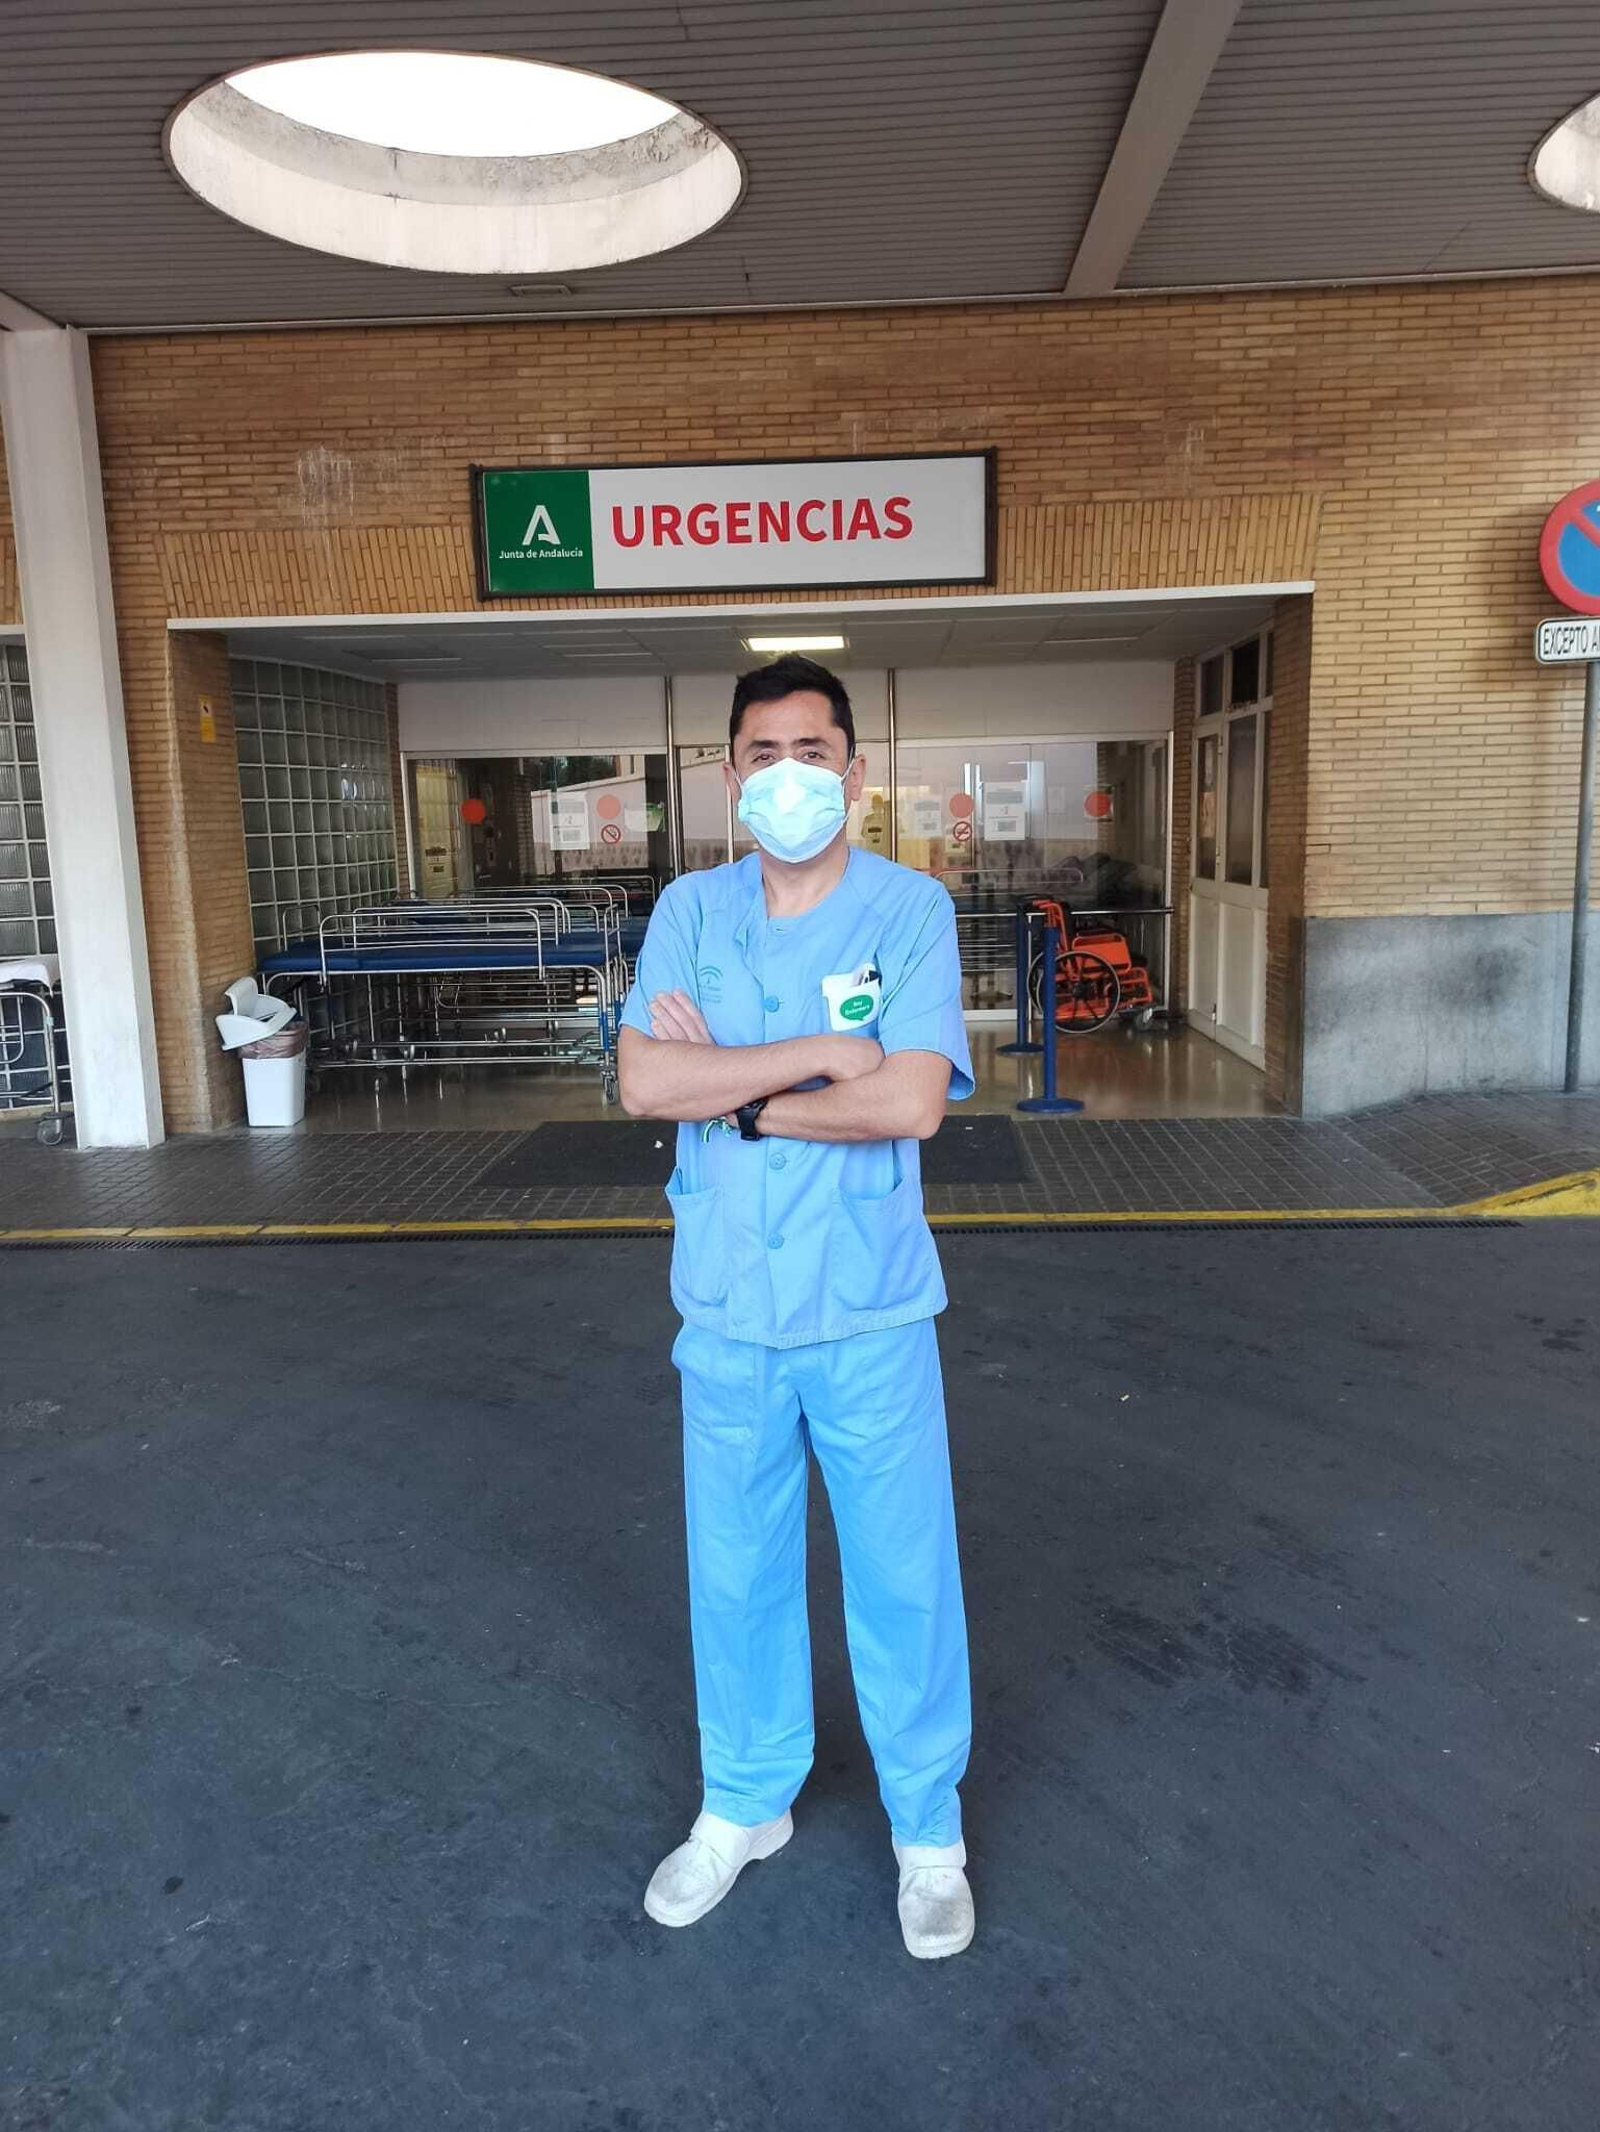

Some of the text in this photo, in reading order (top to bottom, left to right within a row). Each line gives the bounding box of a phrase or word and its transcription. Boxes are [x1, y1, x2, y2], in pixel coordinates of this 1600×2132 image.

[611, 496, 913, 548] URGENCIAS
[499, 550, 525, 558] Junta
[526, 549, 537, 558] de
[1543, 626, 1588, 654] EXCEPTO
